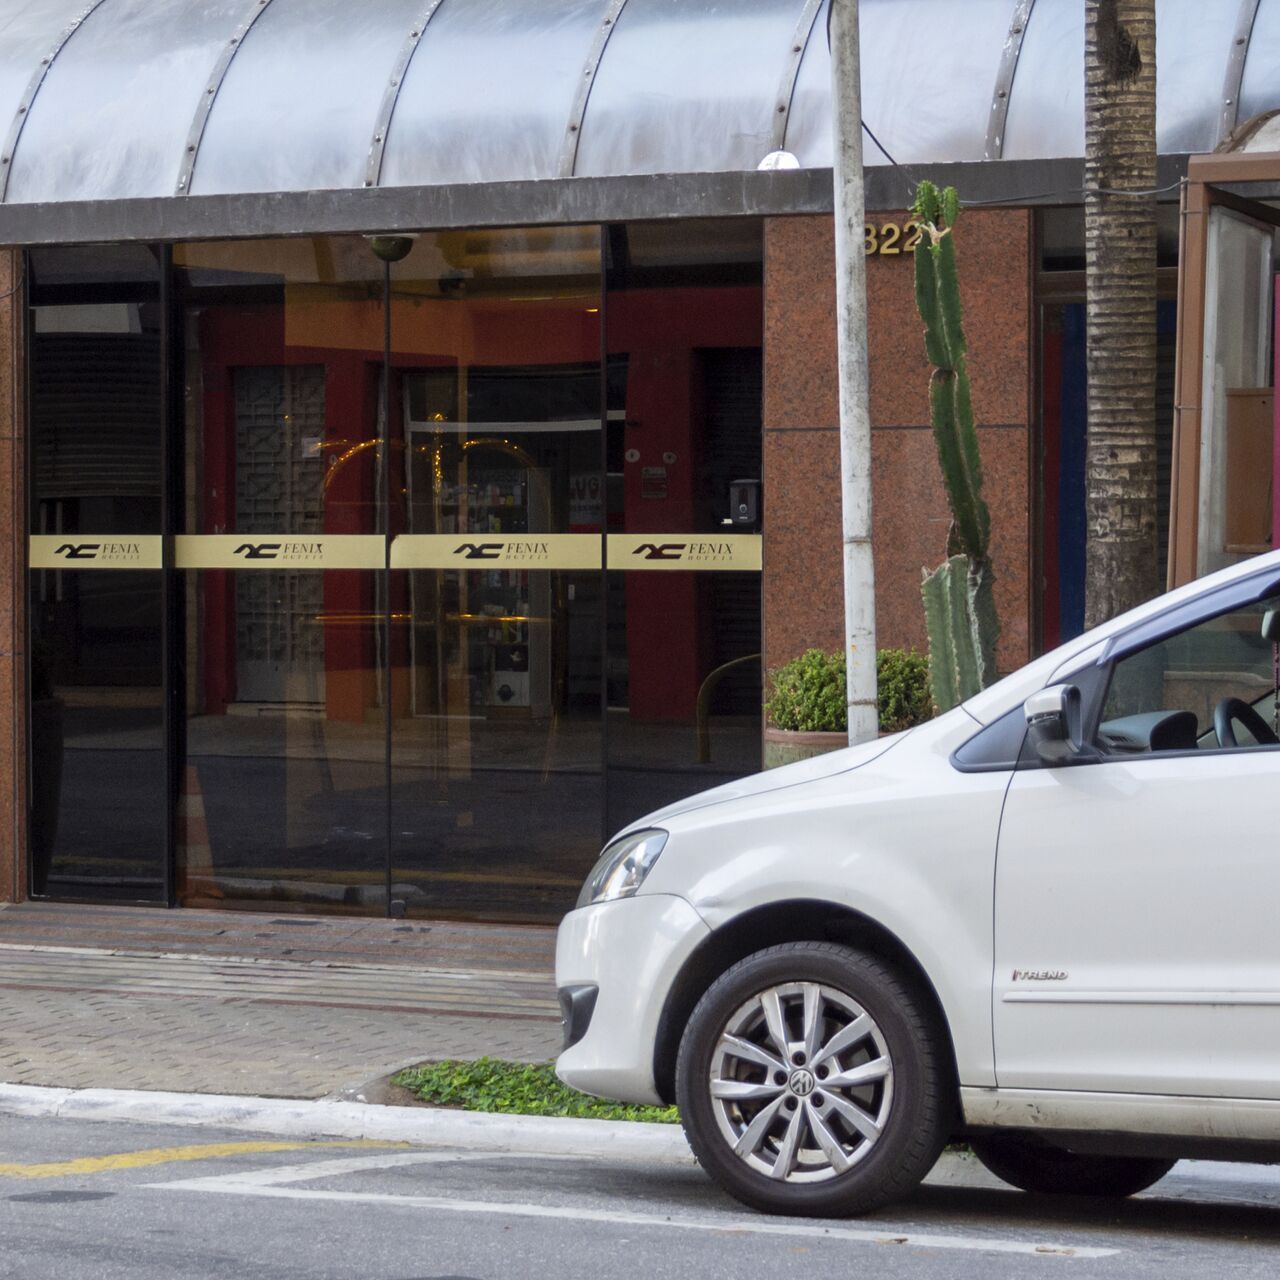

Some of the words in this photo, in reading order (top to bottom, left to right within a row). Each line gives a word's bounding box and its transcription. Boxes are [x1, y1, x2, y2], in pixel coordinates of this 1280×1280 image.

[865, 221, 922, 254] 322
[103, 543, 140, 554] FENIX
[284, 543, 324, 554] FENIX
[506, 542, 550, 554] FENIX
[689, 542, 734, 555] FENIX
